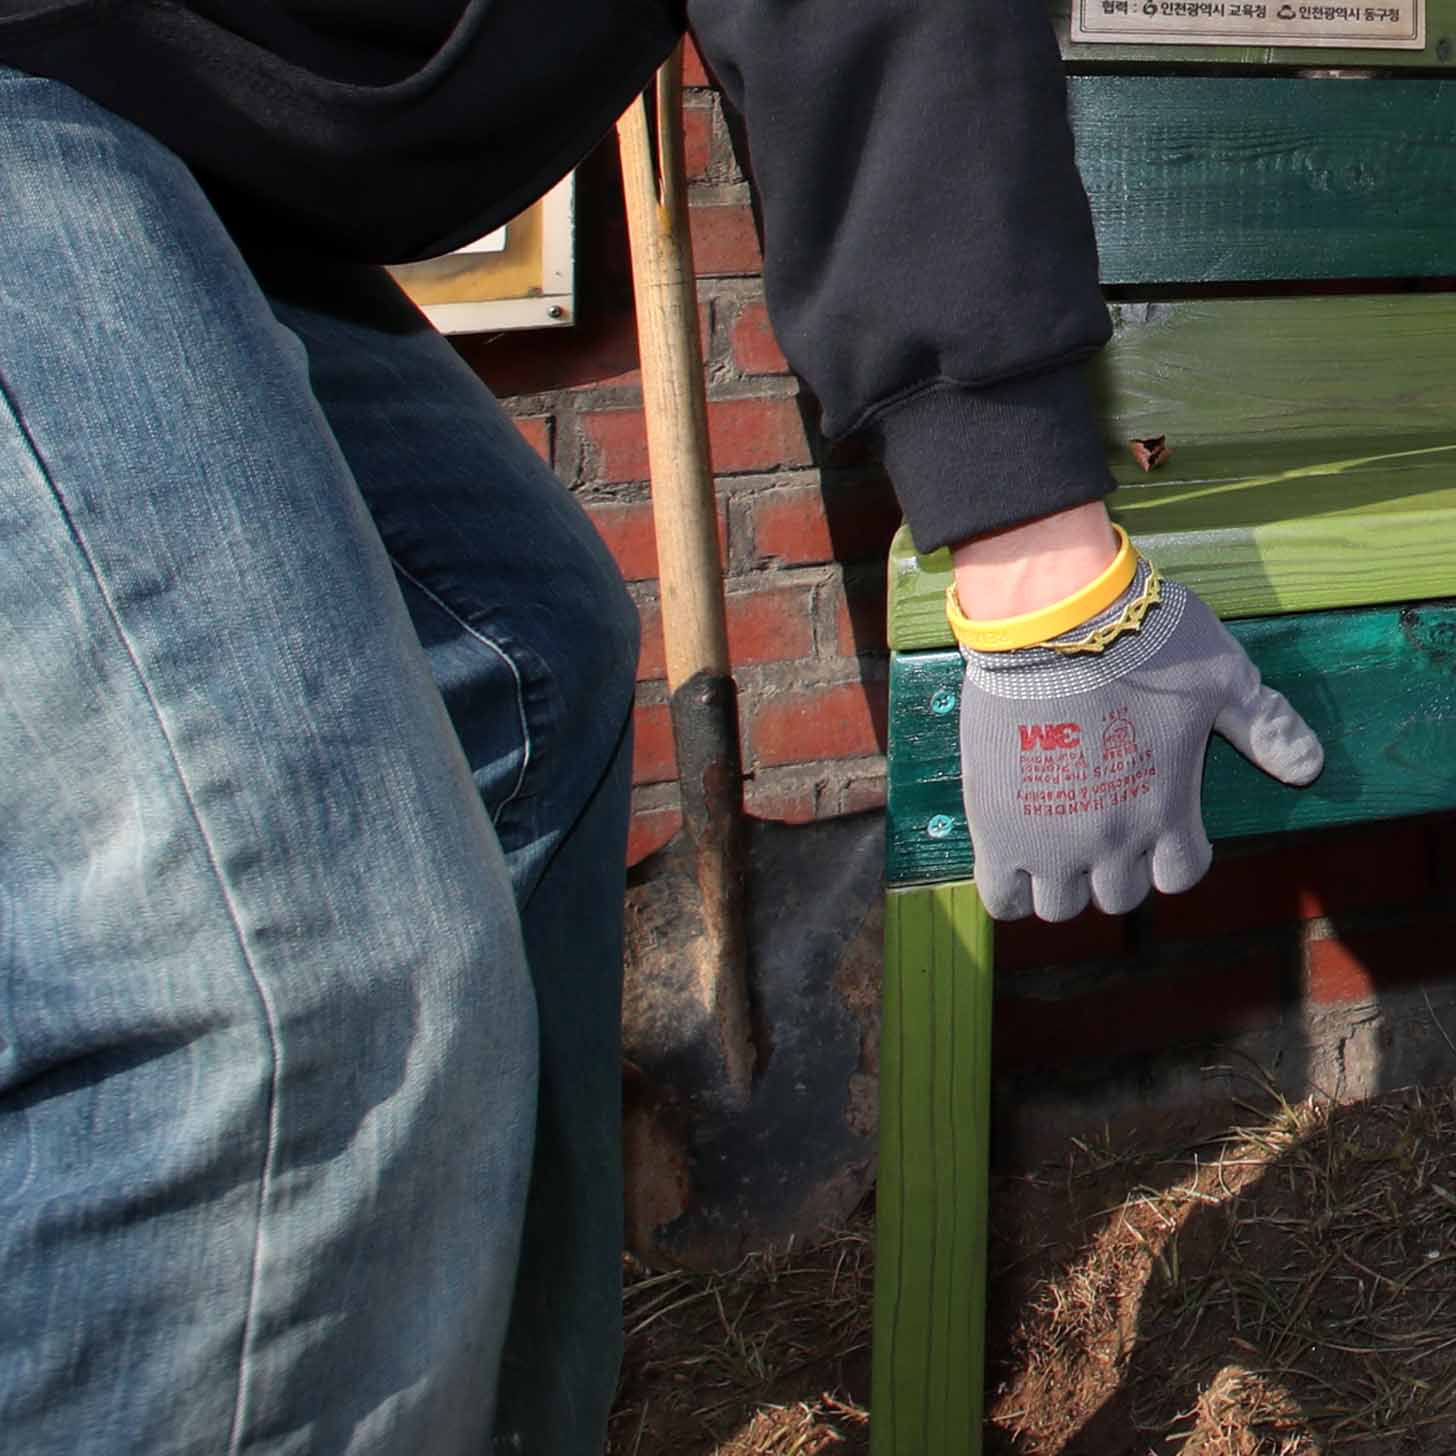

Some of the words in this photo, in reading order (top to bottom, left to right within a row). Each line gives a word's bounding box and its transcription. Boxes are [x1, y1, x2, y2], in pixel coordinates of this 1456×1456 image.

[1160, 1, 1225, 17] 인천광역시
[1299, 5, 1360, 21] 인천광역시
[1016, 722, 1082, 753] 3M
